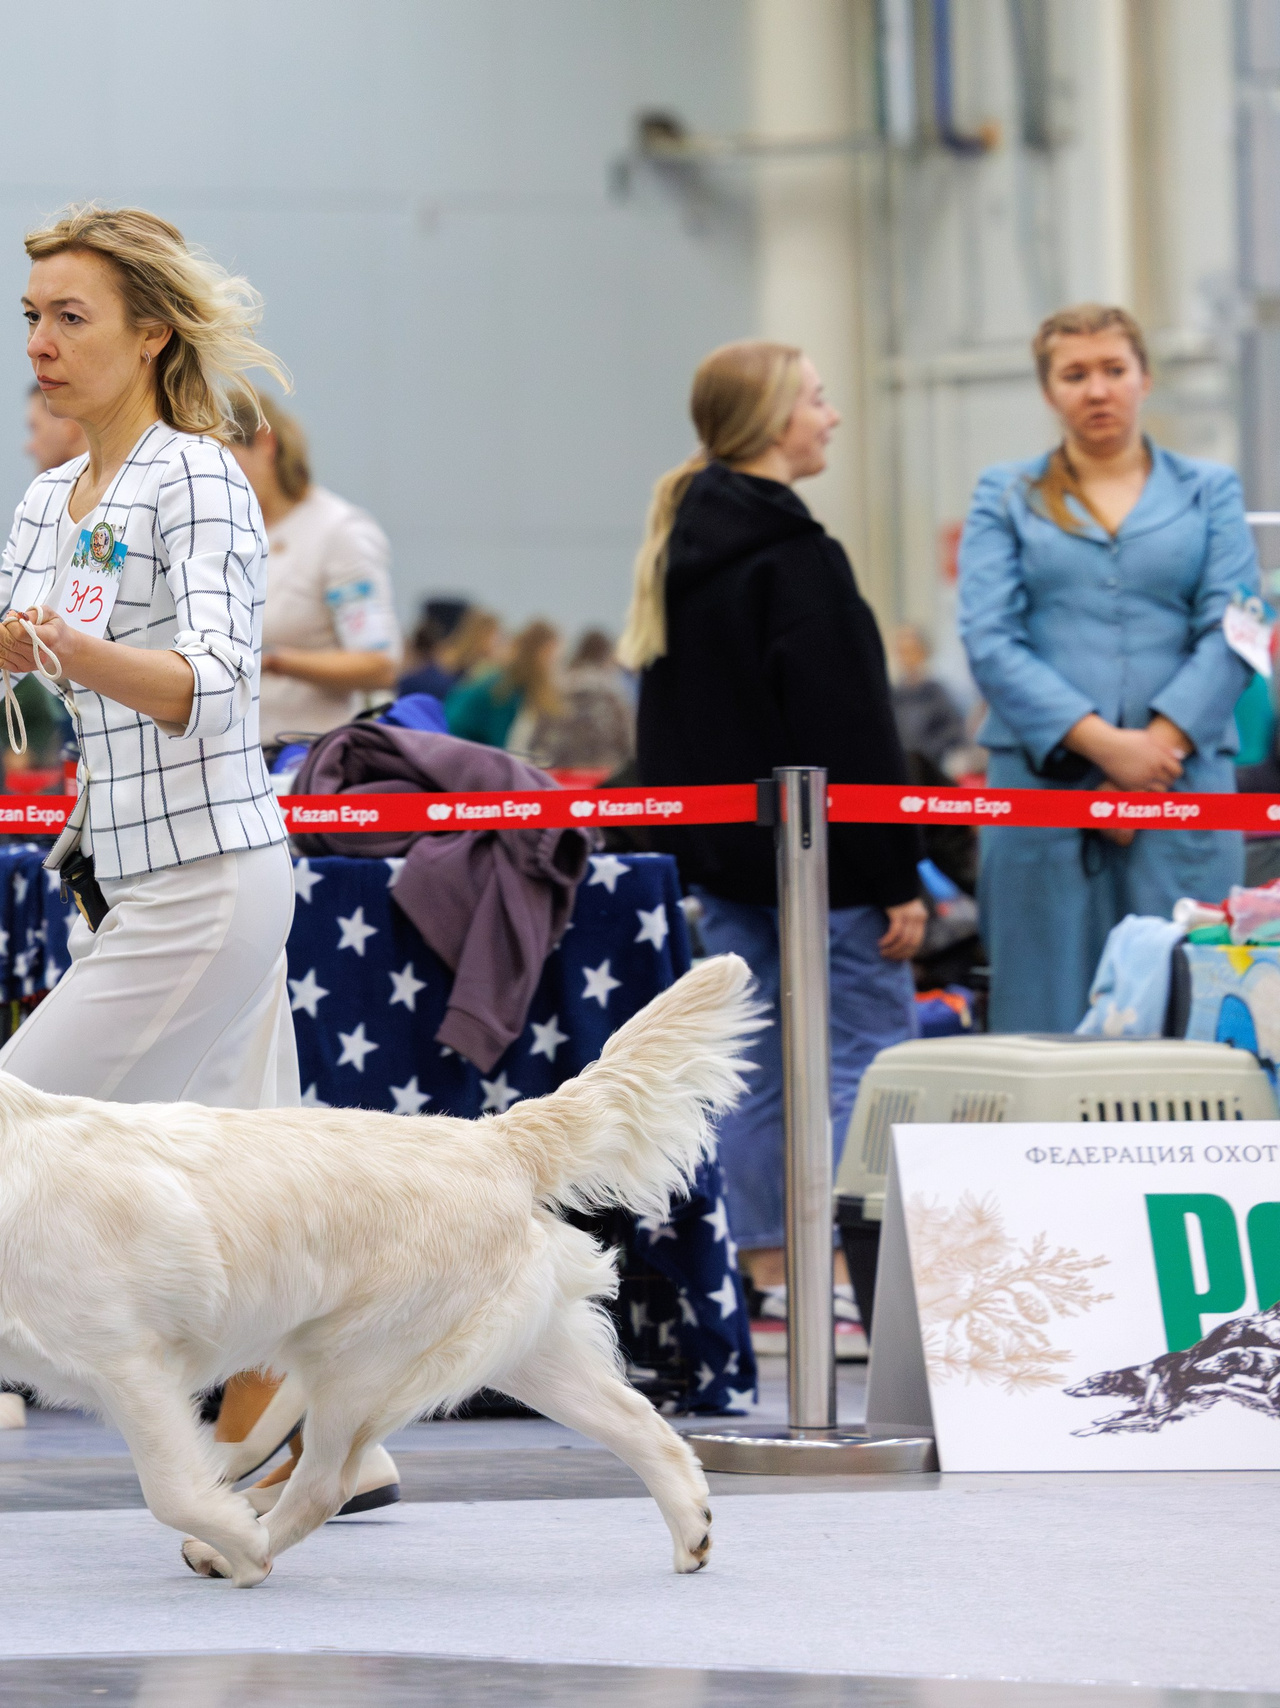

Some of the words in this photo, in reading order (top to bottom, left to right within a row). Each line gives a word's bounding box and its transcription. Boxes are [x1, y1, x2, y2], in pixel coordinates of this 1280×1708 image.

[26, 805, 66, 827] Expo
[291, 806, 339, 824] Kazan
[340, 805, 379, 827] Expo
[455, 802, 502, 820] Kazan
[503, 801, 542, 821] Expo
[597, 799, 644, 817] Kazan
[645, 797, 683, 818] Expo
[927, 797, 973, 814] Kazan
[974, 797, 1012, 818] Expo
[1117, 801, 1162, 818] Kazan
[1163, 801, 1200, 821] Expo
[1025, 1146, 1194, 1166] ФЕДЕРАЦИЯ
